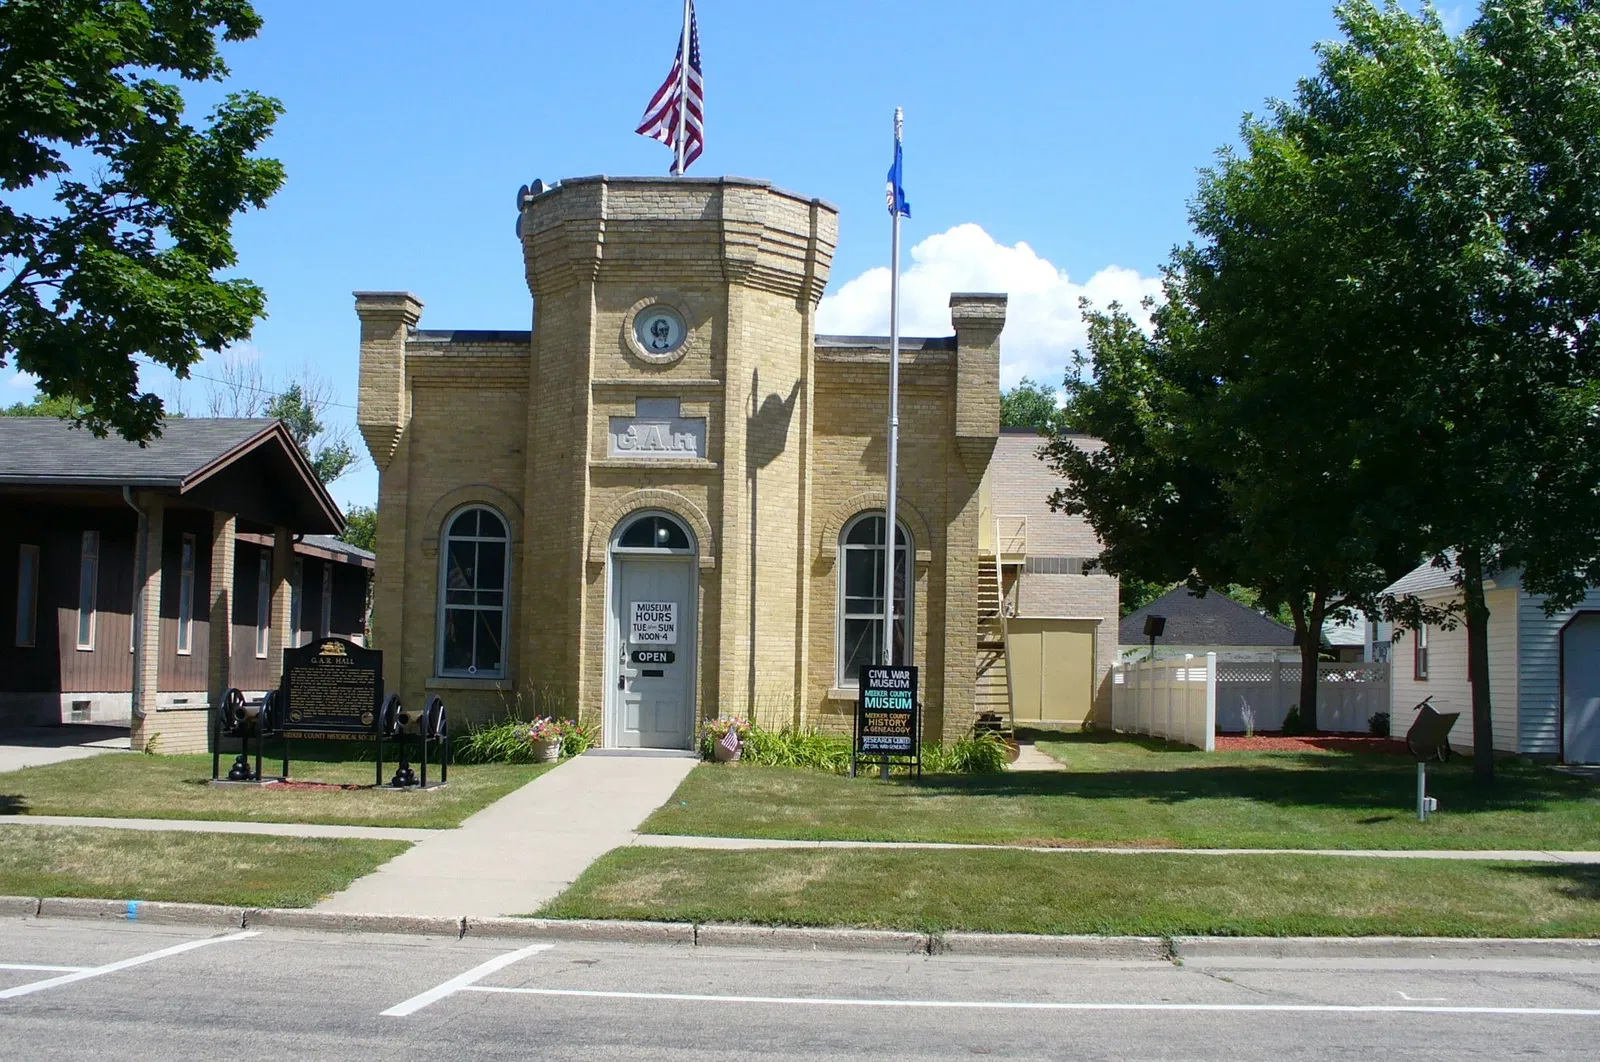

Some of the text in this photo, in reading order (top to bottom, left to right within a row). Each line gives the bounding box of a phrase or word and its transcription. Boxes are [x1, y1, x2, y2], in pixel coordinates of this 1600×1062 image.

[637, 604, 671, 612] MUSEUM
[636, 612, 672, 622] HOURS
[633, 623, 647, 632] TUE
[658, 624, 674, 632] SUN
[638, 652, 667, 662] OPEN
[868, 669, 910, 680] CIVIL WAR
[869, 679, 910, 689] MUSEUM
[864, 689, 912, 698] MEEKER COUNTY
[864, 697, 913, 710] MUSEUM
[868, 719, 907, 727] HISTORY
[870, 726, 911, 734] GENEALOGY
[327, 732, 357, 740] HISTORICAL
[358, 733, 377, 741] SOCIET
